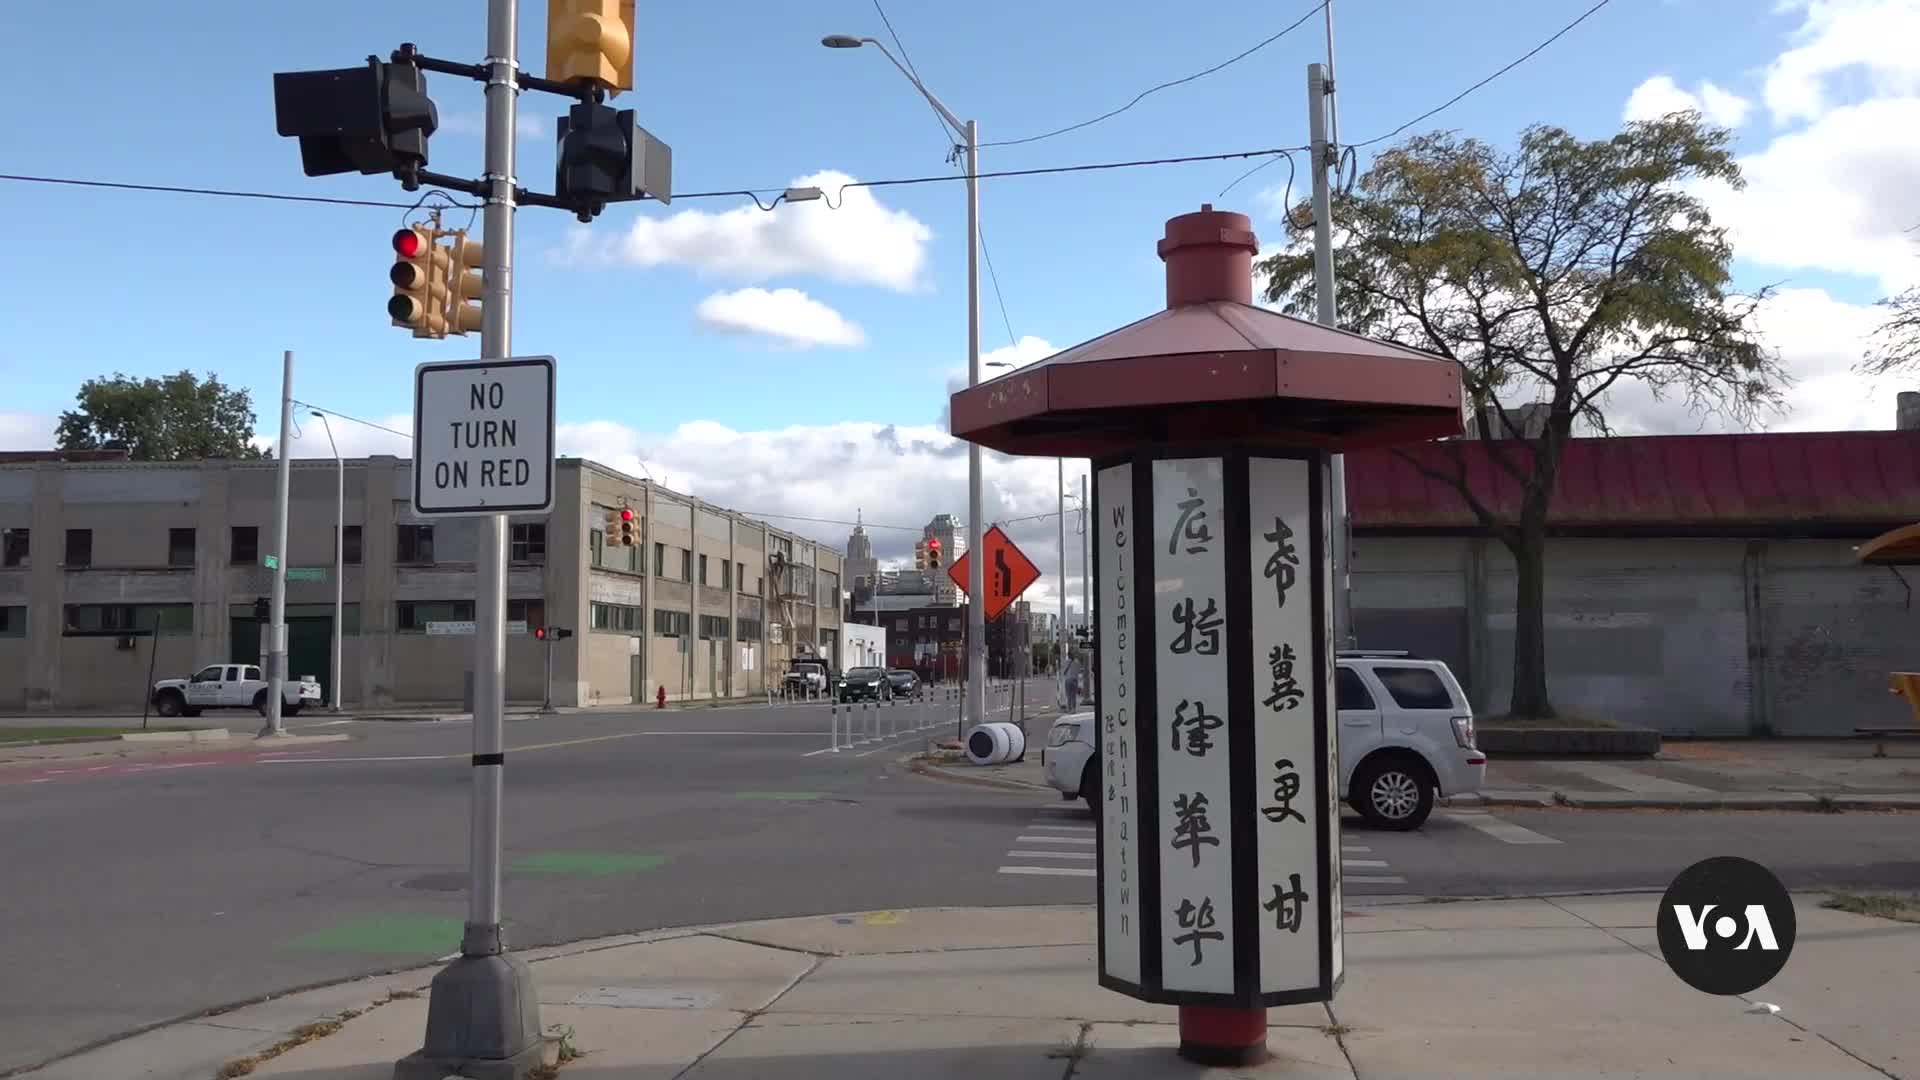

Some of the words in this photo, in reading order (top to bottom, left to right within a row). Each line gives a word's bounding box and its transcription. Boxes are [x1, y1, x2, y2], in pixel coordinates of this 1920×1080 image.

[470, 382, 504, 410] NO
[450, 419, 517, 449] TURN
[435, 460, 468, 489] ON
[480, 458, 530, 487] RED
